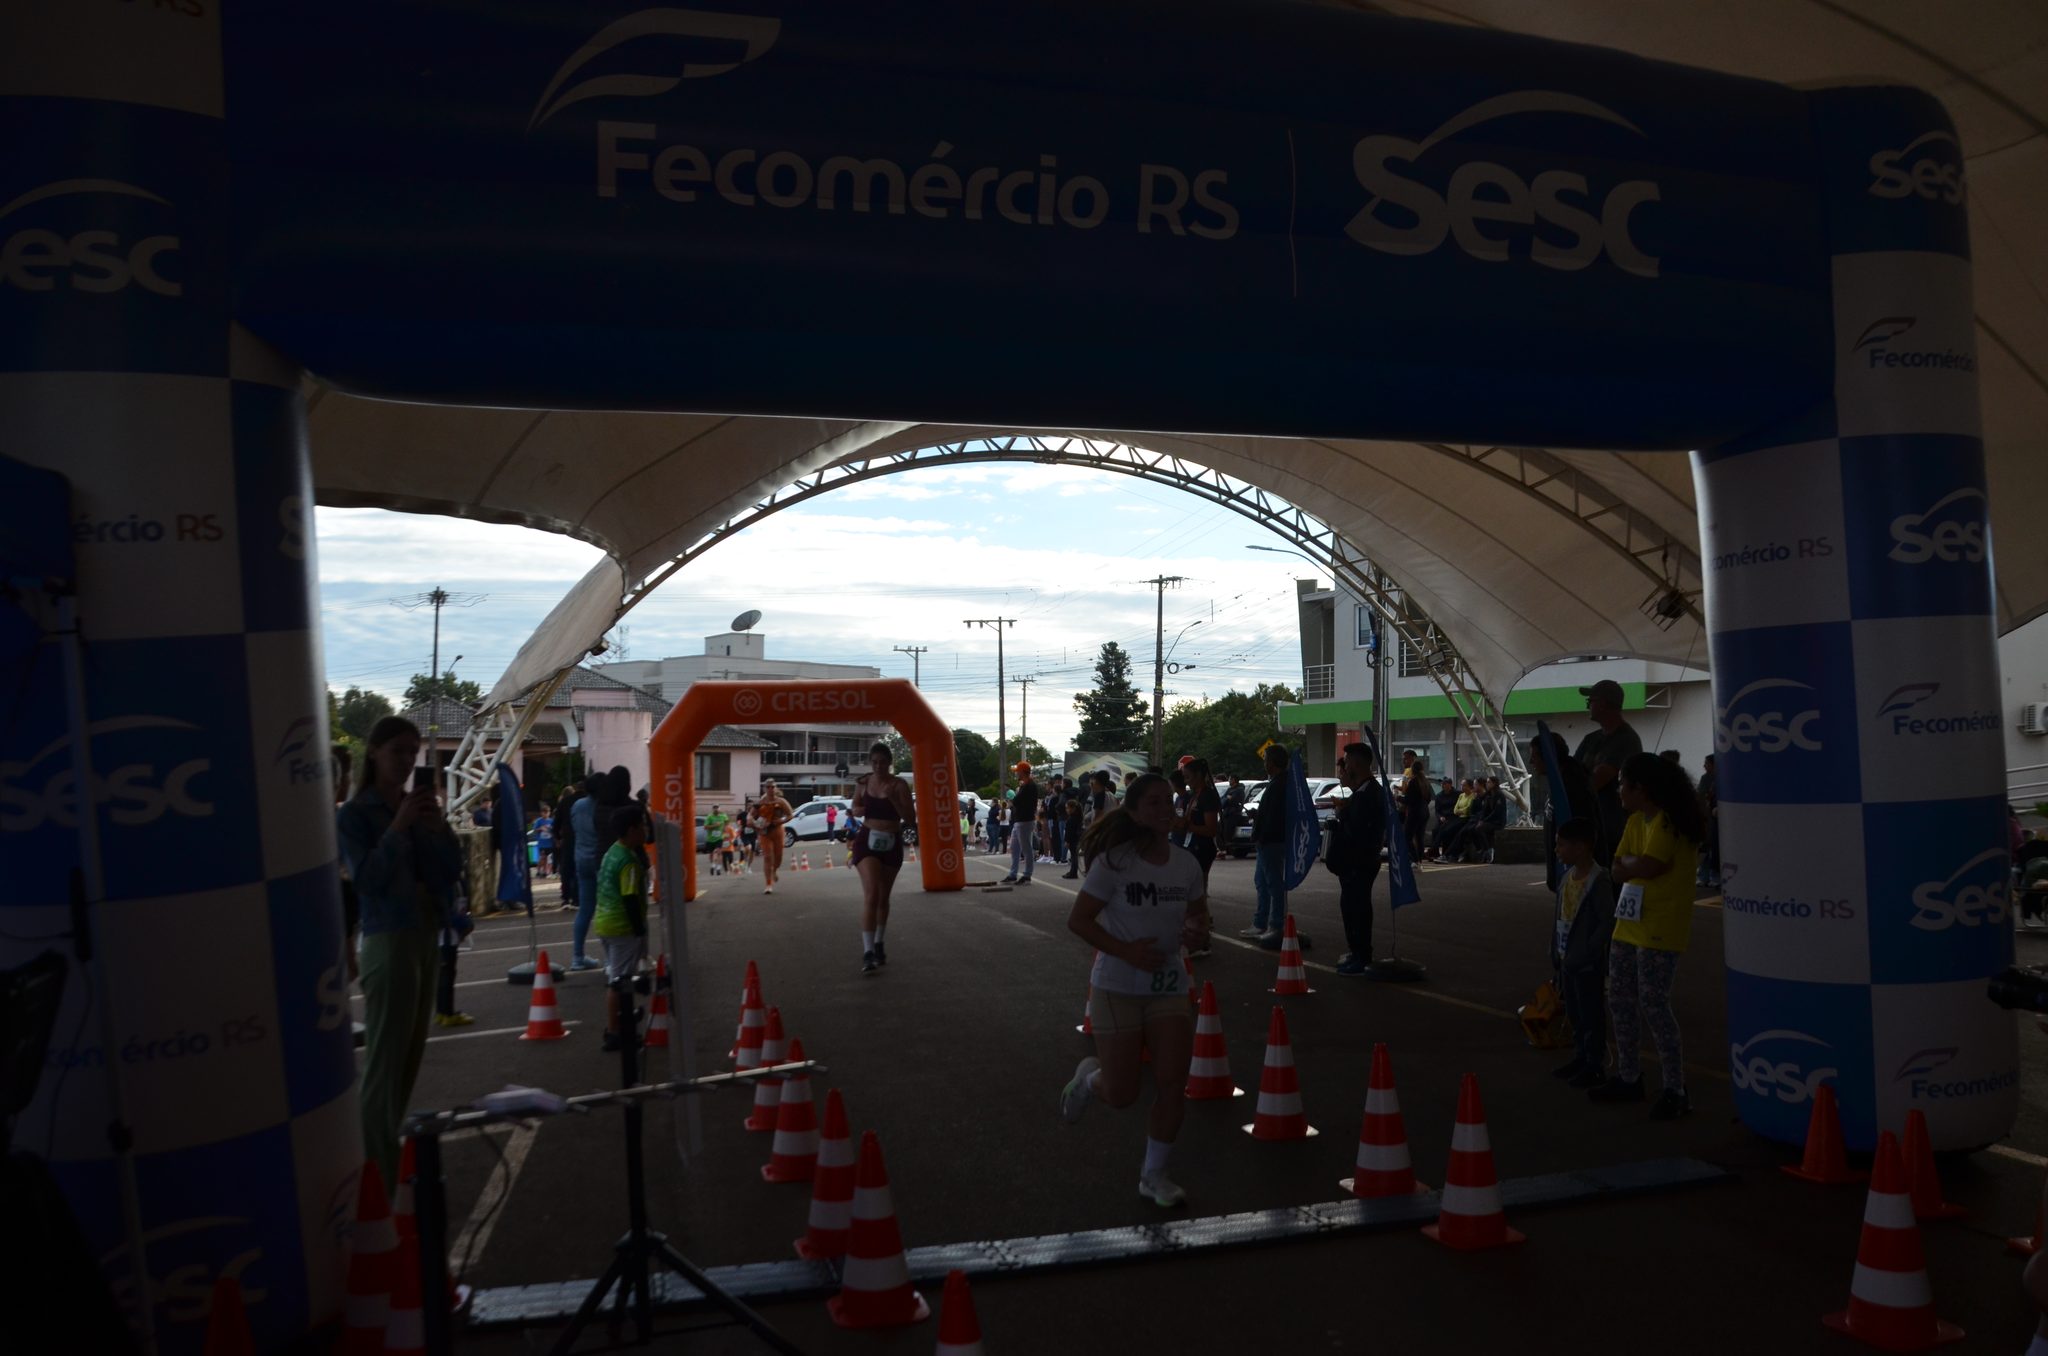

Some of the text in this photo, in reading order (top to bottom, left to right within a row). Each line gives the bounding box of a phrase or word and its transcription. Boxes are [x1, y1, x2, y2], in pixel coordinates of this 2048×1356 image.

[596, 119, 1241, 241] Fecomércio RS
[1343, 133, 1662, 280] Sesc
[176, 514, 224, 542] RS
[1798, 536, 1834, 558] RS
[770, 688, 876, 712] CRESOL
[932, 754, 955, 843] CRESOL
[1820, 899, 1855, 919] RS
[1151, 969, 1178, 992] 82
[222, 1015, 266, 1048] RS
